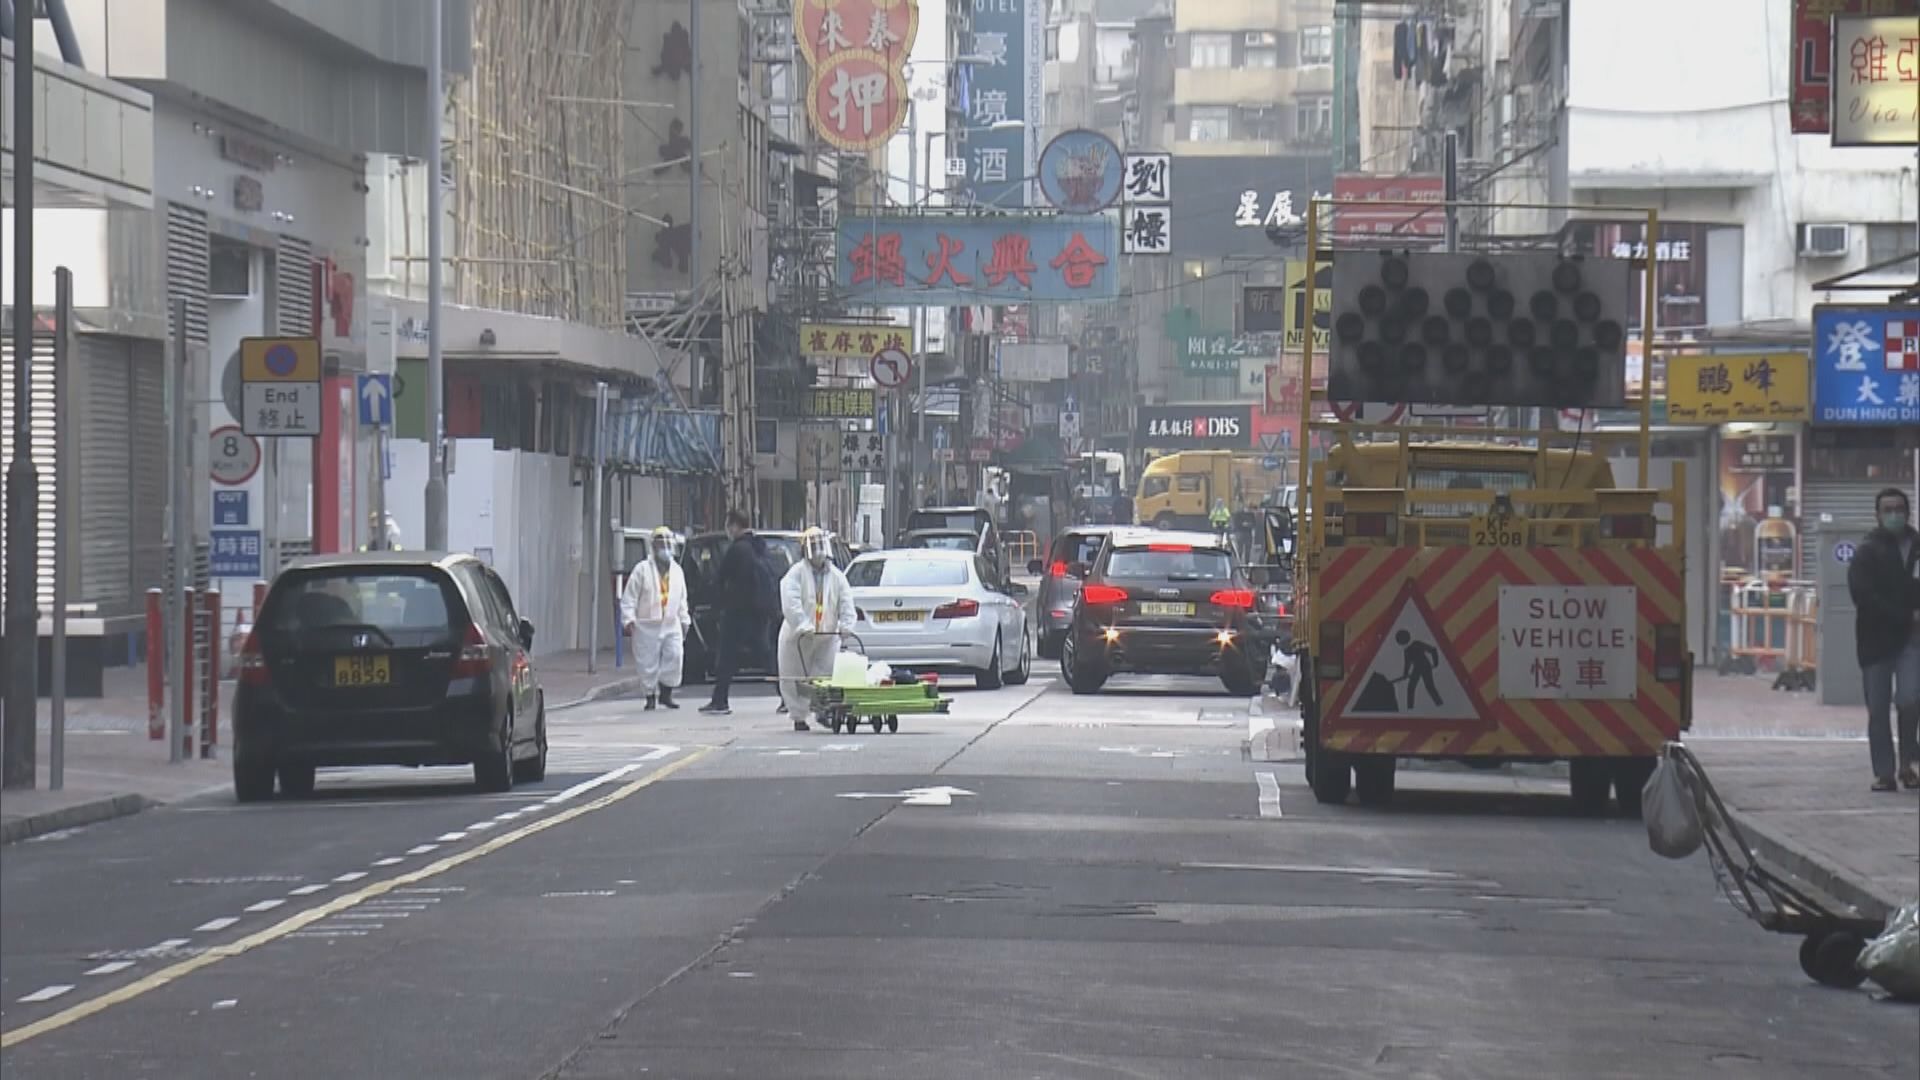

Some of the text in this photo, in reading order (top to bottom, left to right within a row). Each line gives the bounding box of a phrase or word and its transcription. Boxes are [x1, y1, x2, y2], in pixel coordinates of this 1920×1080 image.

[829, 68, 888, 136] 押
[1827, 320, 1881, 370] 登
[1697, 358, 1777, 398] 鵬峰
[265, 388, 299, 403] End
[258, 409, 307, 430] 終止
[1824, 407, 1857, 420] DUN
[1860, 407, 1897, 420] HING
[1208, 418, 1239, 436] DBS
[222, 436, 239, 457] 8
[1529, 597, 1607, 620] SLOW
[1512, 628, 1625, 648] VEHICLE
[1530, 656, 1607, 690] 慢車
